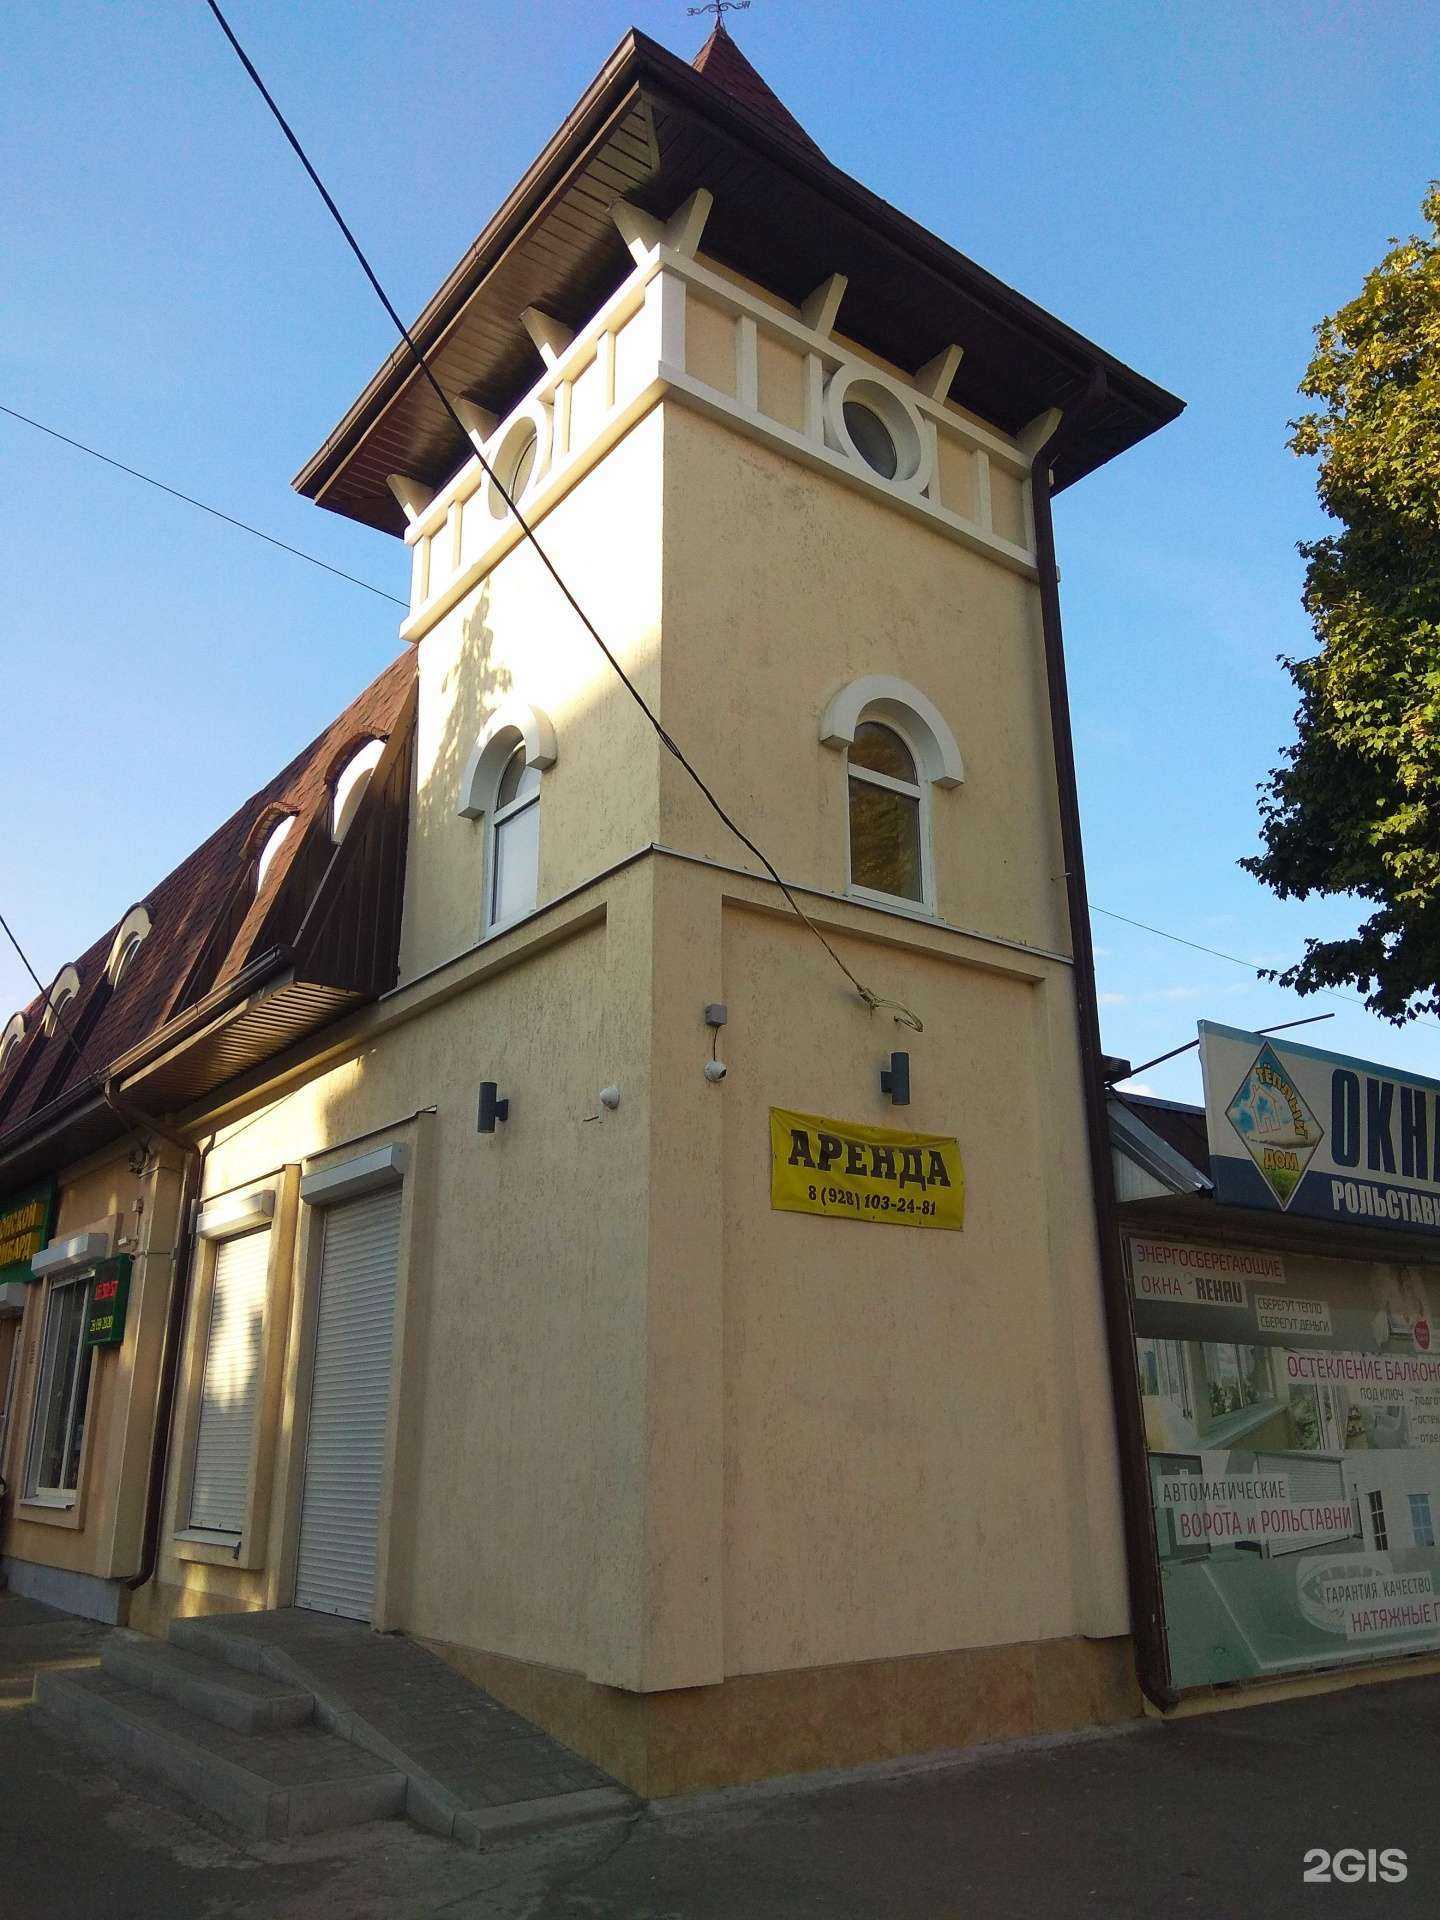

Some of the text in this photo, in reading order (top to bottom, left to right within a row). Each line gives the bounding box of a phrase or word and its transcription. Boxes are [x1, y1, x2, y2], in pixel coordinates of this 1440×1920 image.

[788, 1129, 951, 1191] АРЕНДА
[1263, 1148, 1300, 1171] ДОМ
[808, 1185, 936, 1216] 8 (928) 103-24-81
[1136, 1244, 1282, 1278] ЭНЕРГОСБЕРЕГАЮЩИЕ
[1141, 1275, 1183, 1297] ОКНА
[1287, 1356, 1440, 1383] ОСТЕКЛЕНИЕ БАЛКОН
[1163, 1480, 1287, 1502] АВТОМАТИЧЕСКИЕ
[1180, 1511, 1242, 1538] ВОРОТА
[1261, 1506, 1352, 1534] РОЛЬСТАВНИ
[1383, 1577, 1431, 1598] КАЧЕСТВО
[1352, 1603, 1431, 1633] НАТЯЖНЫЕ
